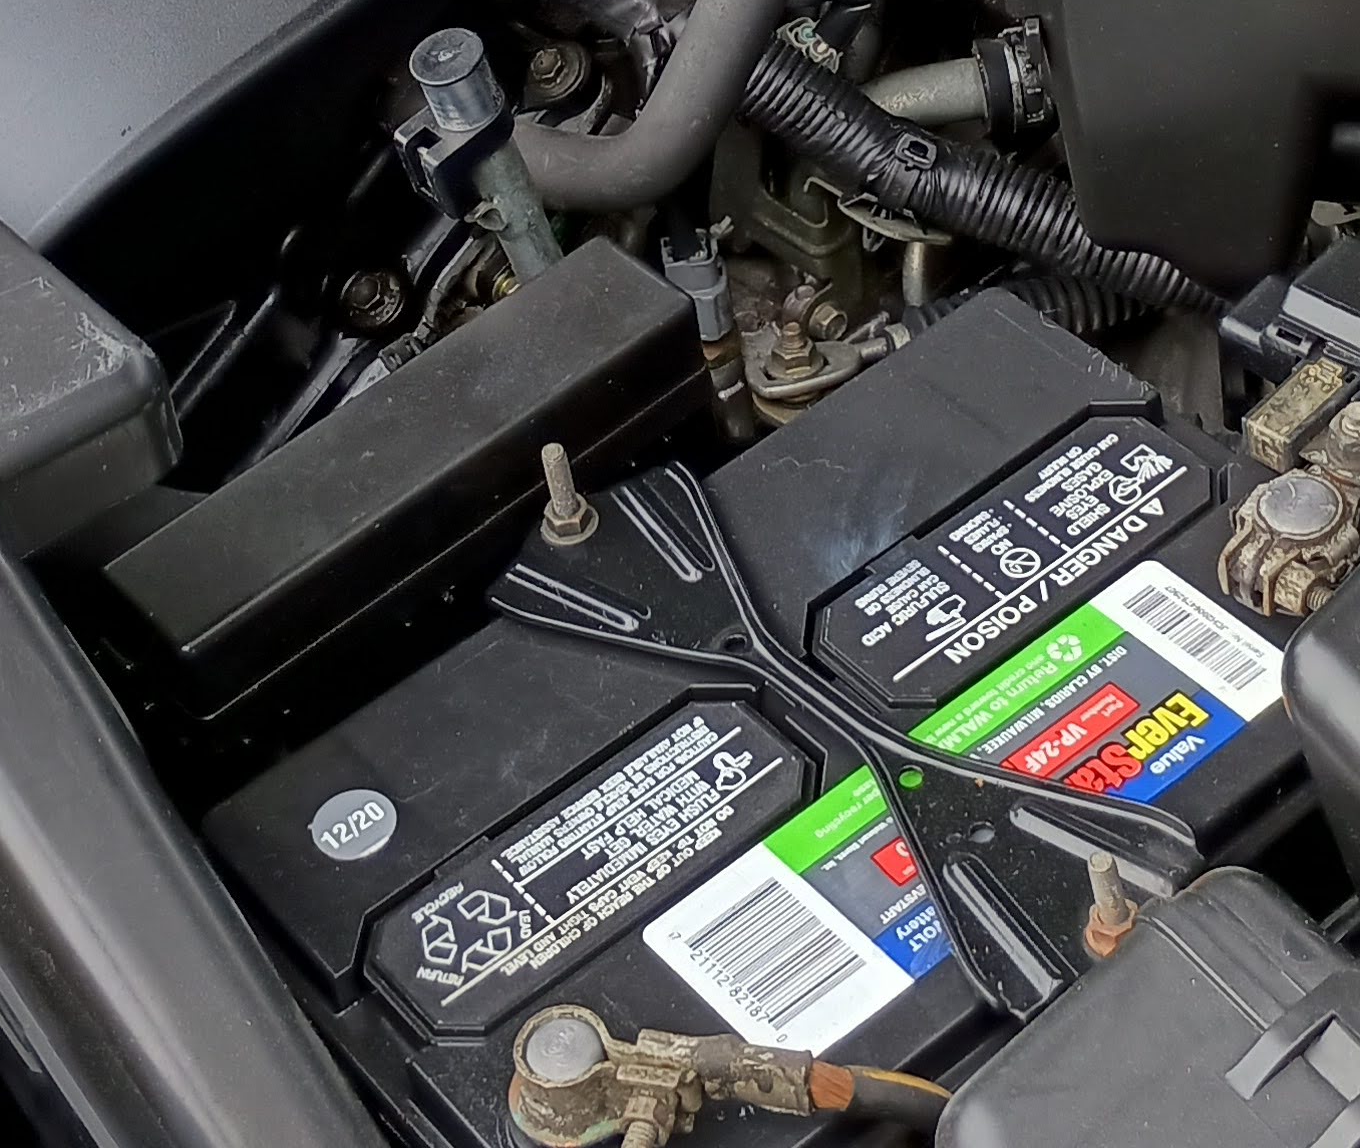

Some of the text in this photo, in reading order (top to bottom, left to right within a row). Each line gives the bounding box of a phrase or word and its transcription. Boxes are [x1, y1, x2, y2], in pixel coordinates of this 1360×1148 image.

[1048, 465, 1114, 519] EXPLOSIVE
[1059, 458, 1103, 494] GASES
[1063, 492, 1100, 522] EYES
[1064, 500, 1111, 538] SHIELD
[988, 536, 1014, 557] NO
[1047, 512, 1148, 589] DANGER
[915, 573, 940, 592] CAN
[859, 579, 951, 648] SULFURIC ACID
[942, 592, 1038, 666] POISON
[1004, 659, 1059, 702] Return
[976, 643, 1128, 758] DIST. BY CLARIOS, MILWAUKEE,
[987, 694, 1010, 714] to
[1018, 718, 1090, 774] VP-24F
[1067, 692, 1210, 792] EverSta
[1145, 730, 1207, 777] Value
[673, 778, 711, 808] WITH
[320, 801, 385, 849] 12/20
[577, 769, 701, 860] MEDICAL HELP FAST
[691, 817, 718, 838] NOT
[712, 804, 735, 822] DO
[562, 787, 721, 906] FLUSH EYES IMMEDIATELY
[601, 834, 633, 860] GET
[642, 848, 673, 873] KEEP
[668, 845, 695, 867] OUT
[629, 873, 656, 896] THE
[651, 861, 673, 880] OF
[409, 880, 467, 924] RECYCLE
[587, 887, 618, 913] CAPS
[595, 889, 634, 921] REACH
[519, 910, 530, 938] LEAD
[553, 907, 590, 937] TIGHT
[579, 914, 599, 932] OF
[892, 904, 939, 940] attery
[498, 947, 535, 978] LEVEL
[527, 926, 583, 970] CHILDREN
[689, 949, 730, 987] 21112
[729, 985, 770, 1022] 82187
